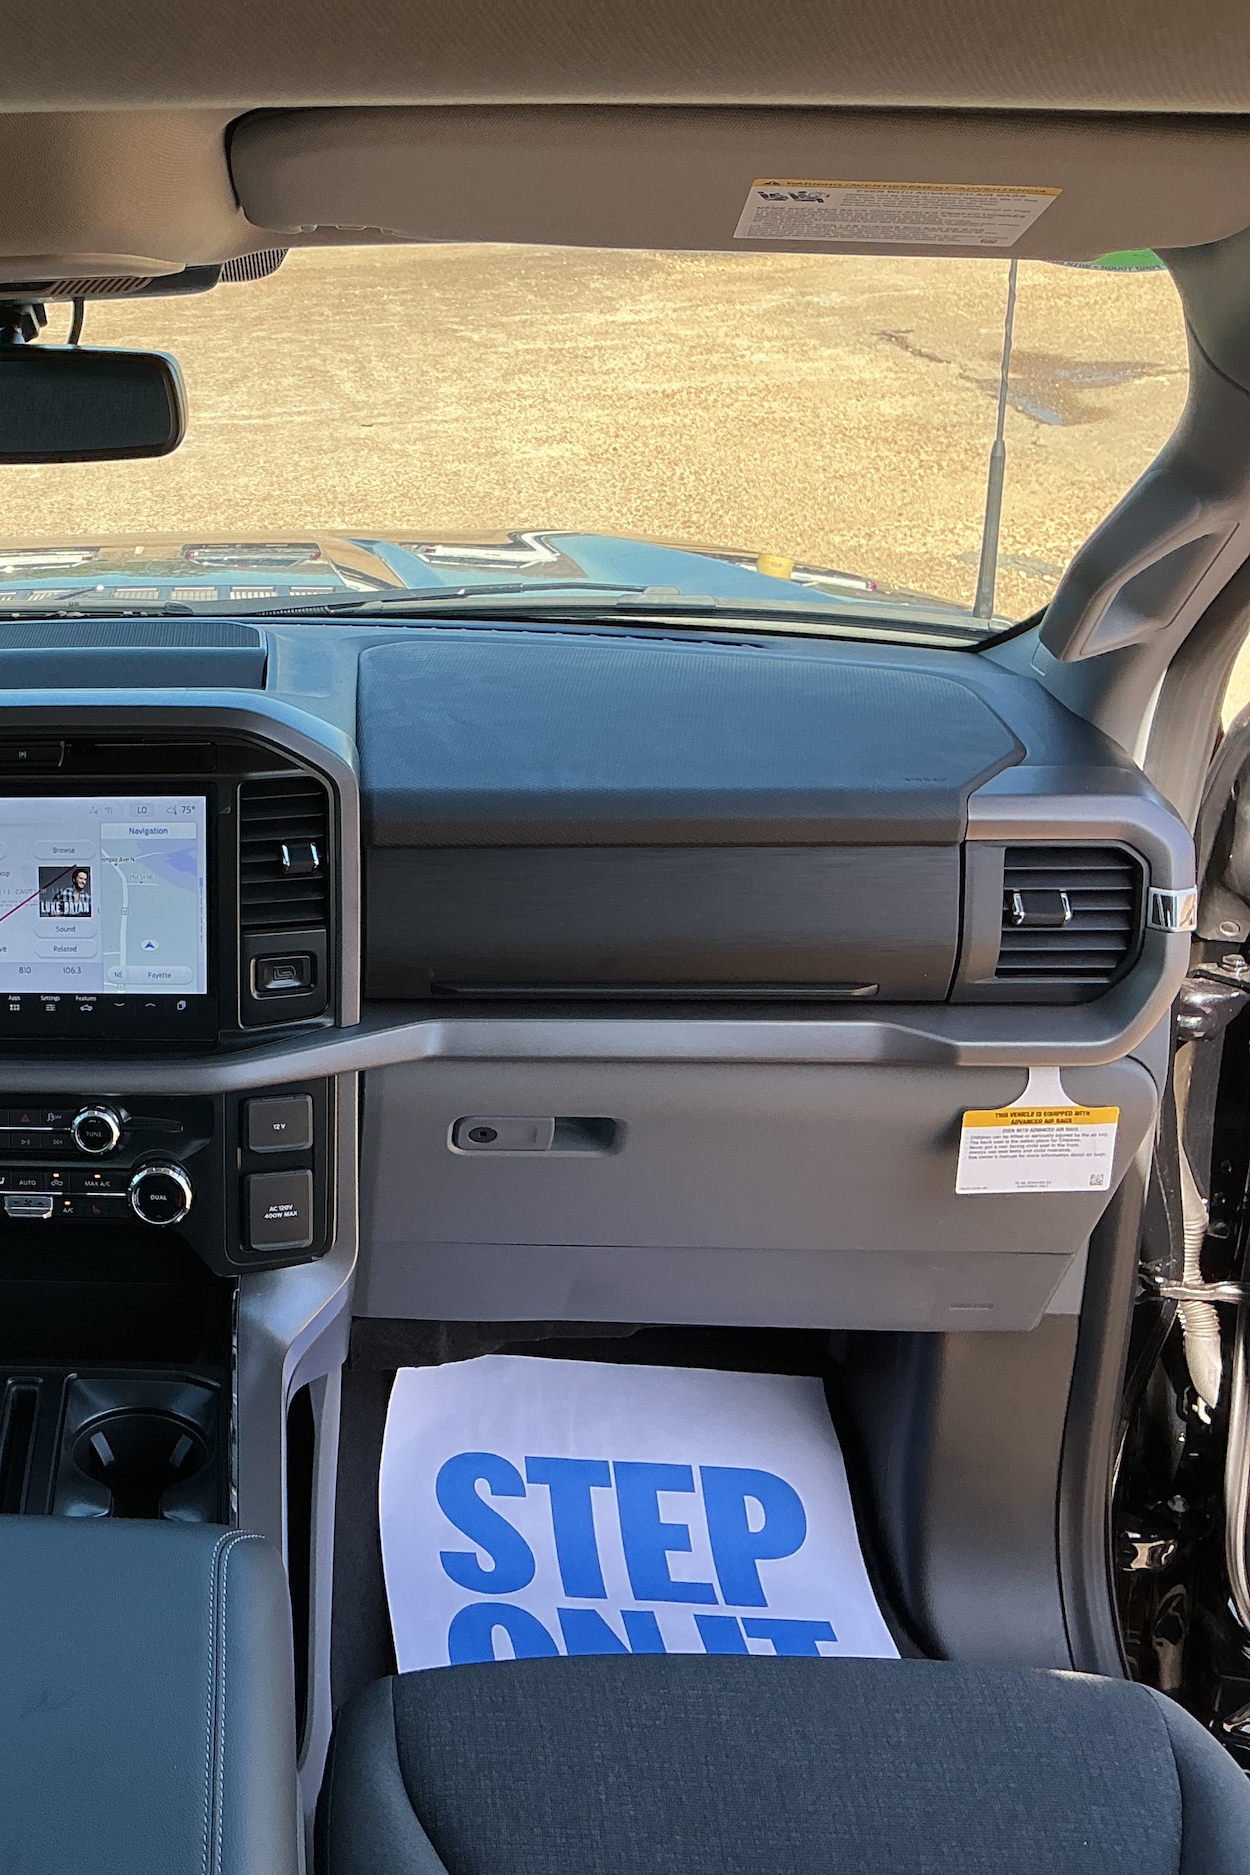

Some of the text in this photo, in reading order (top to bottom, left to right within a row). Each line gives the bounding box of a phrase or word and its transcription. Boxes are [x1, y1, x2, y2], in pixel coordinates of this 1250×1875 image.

[137, 806, 148, 814] LO
[129, 828, 168, 836] Navigation
[41, 901, 61, 913] LUKE
[64, 901, 90, 913] BRYAN
[435, 1451, 806, 1607] STEP
